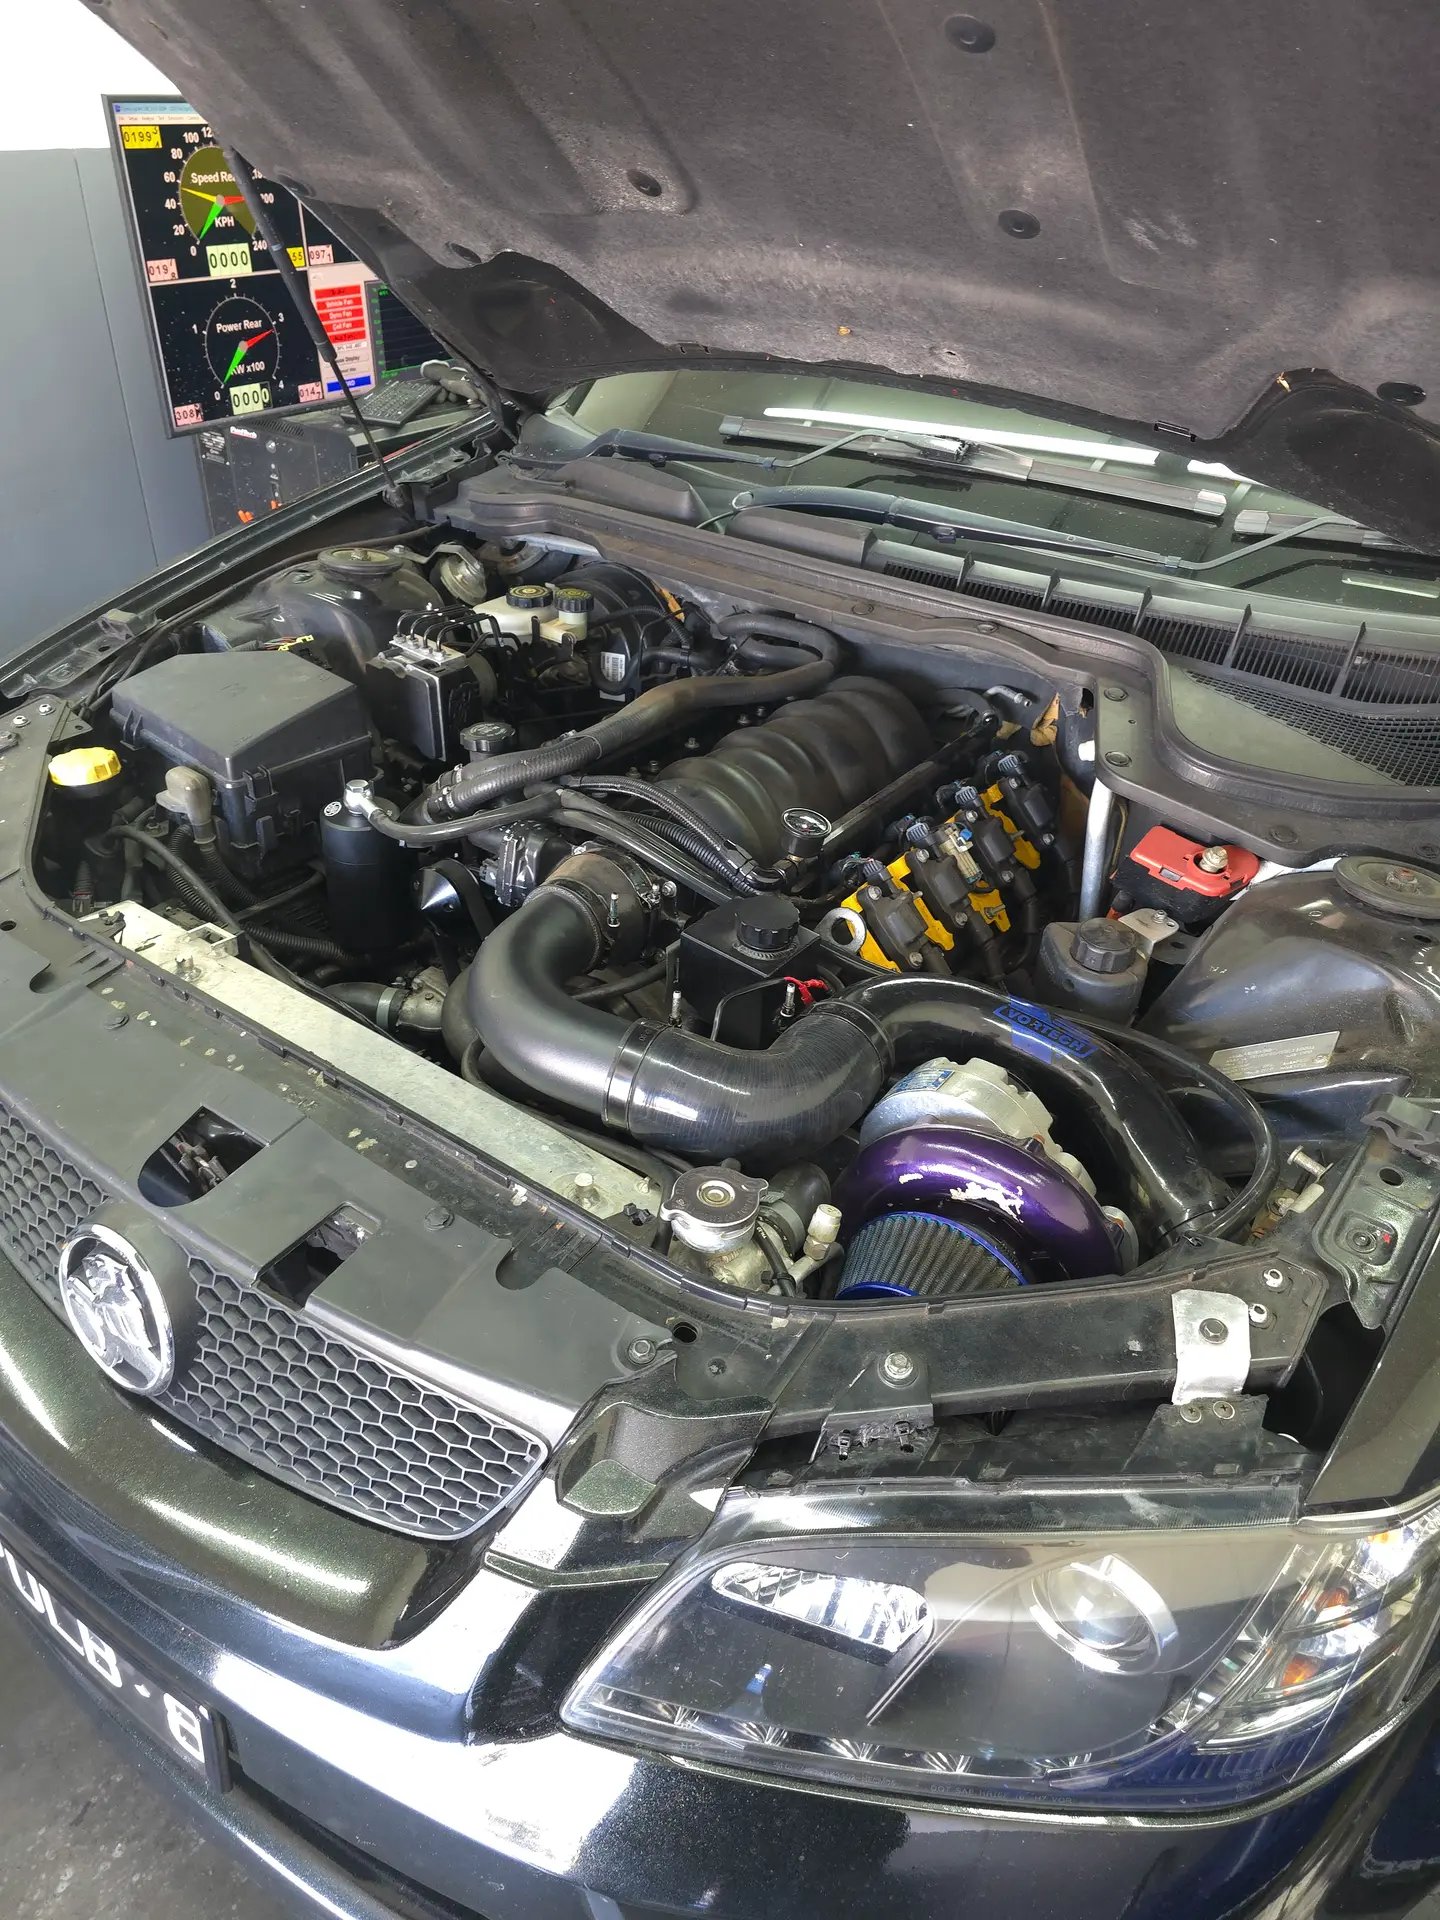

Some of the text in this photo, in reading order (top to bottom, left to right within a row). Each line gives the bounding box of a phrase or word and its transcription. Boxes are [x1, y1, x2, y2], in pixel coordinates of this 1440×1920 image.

[183, 132, 199, 143] 100
[201, 126, 213, 138] 12
[171, 148, 183, 159] 80
[164, 172, 176, 183] 60
[191, 171, 236, 185] Speed Re
[165, 198, 177, 209] 40
[260, 193, 274, 204] 00
[215, 216, 235, 227] KPH
[173, 225, 185, 235] 20
[190, 246, 197, 256] 0
[253, 240, 268, 251] 240
[210, 251, 248, 269] 0000
[230, 279, 237, 288] 2
[278, 313, 284, 322] 3
[192, 324, 198, 334] 1
[216, 319, 262, 333] Power Rear
[278, 380, 285, 389] 4
[214, 391, 220, 400] 0
[233, 388, 270, 408] 0000
[1005, 1006, 1086, 1052] VORTECH
[0, 1537, 122, 1688] ULB
